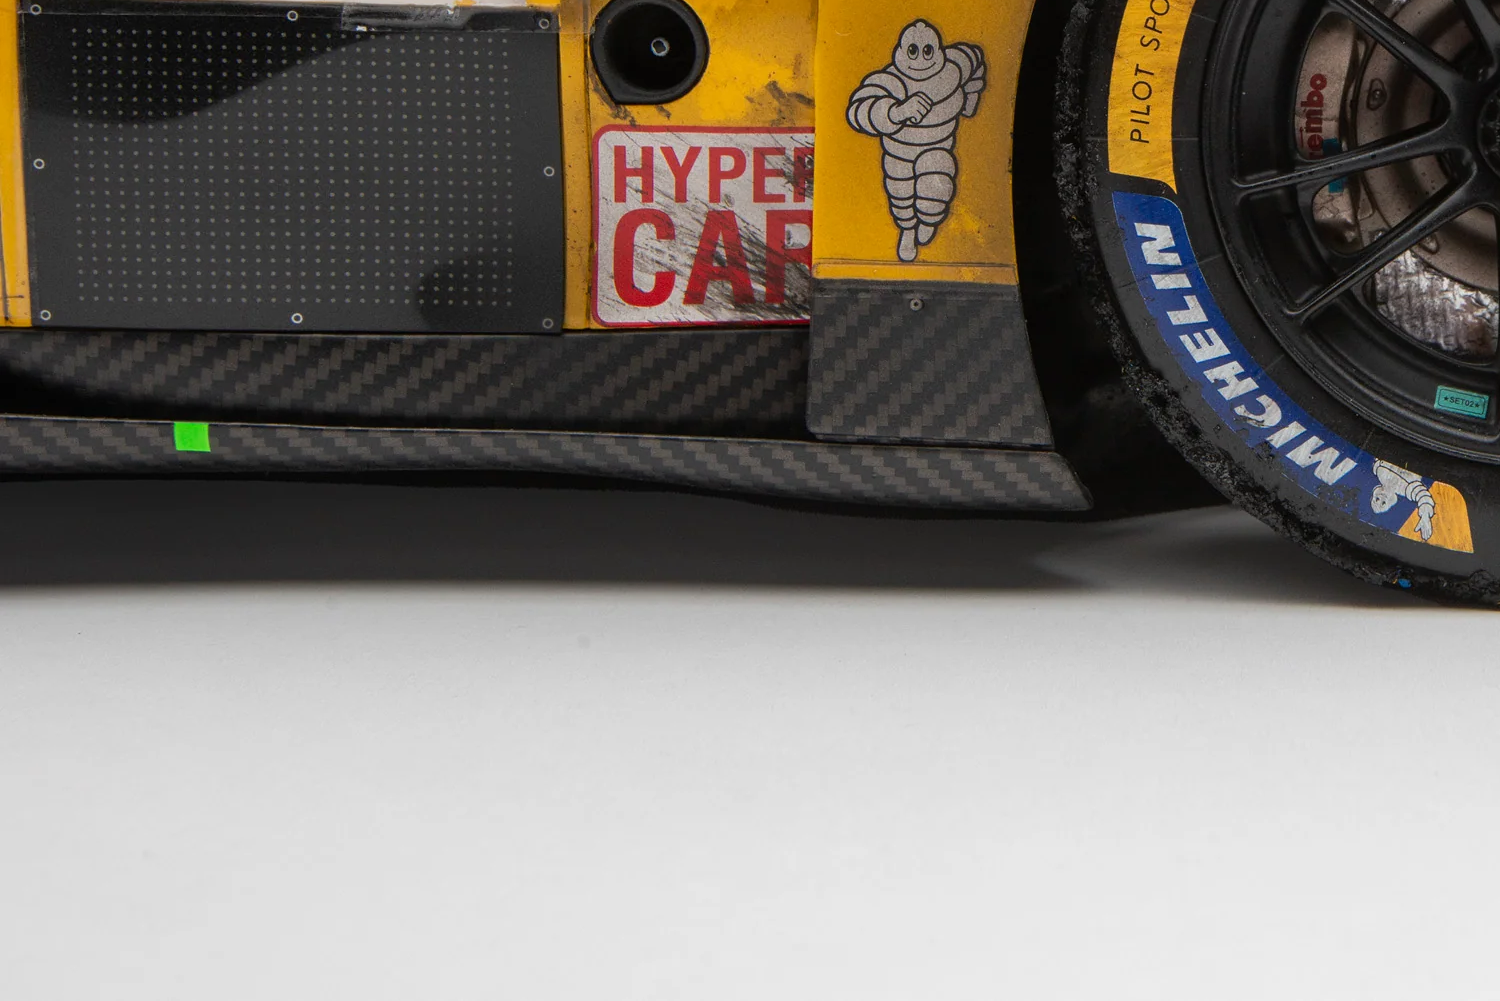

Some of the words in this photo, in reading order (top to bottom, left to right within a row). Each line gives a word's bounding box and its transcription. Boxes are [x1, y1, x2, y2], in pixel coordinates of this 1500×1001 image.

[1130, 63, 1155, 145] PILOT
[1301, 73, 1328, 160] rembo
[1134, 222, 1359, 486] MICHELIN
[1449, 396, 1476, 409] SET02
